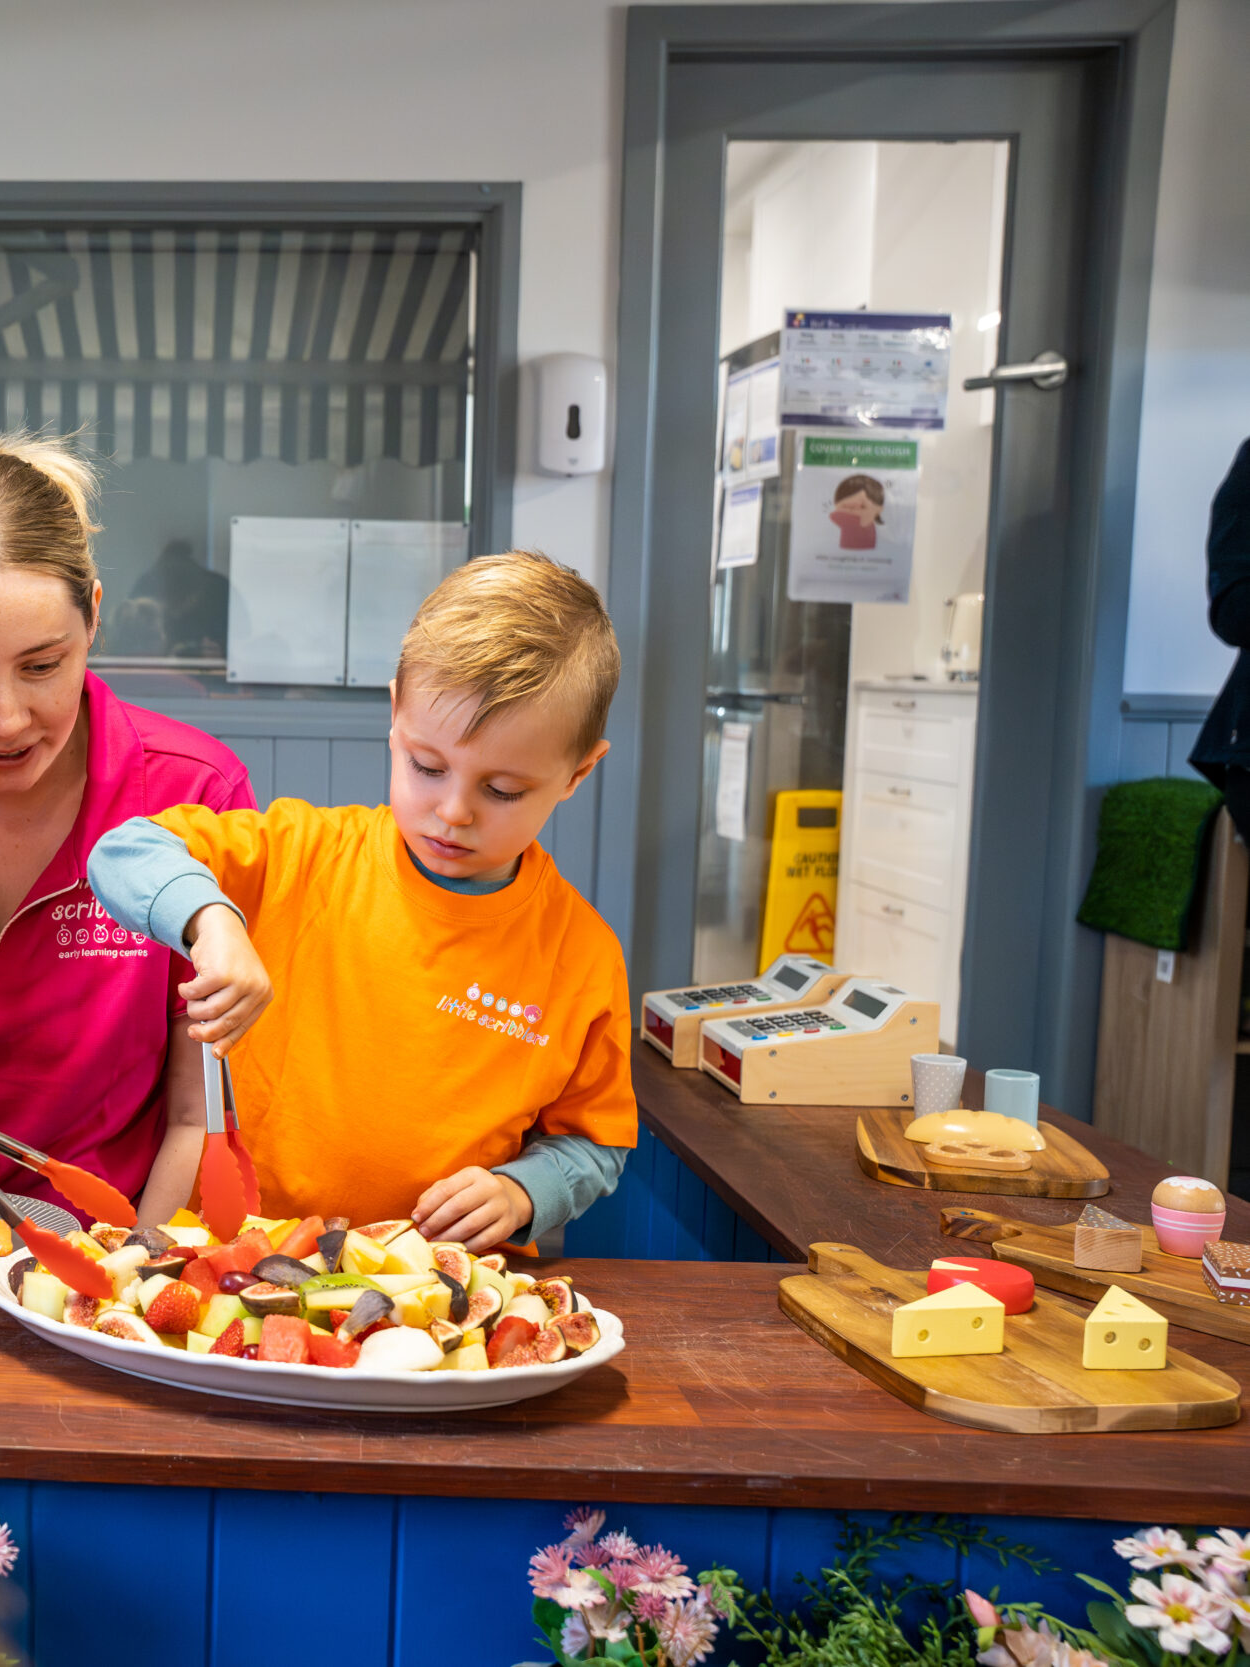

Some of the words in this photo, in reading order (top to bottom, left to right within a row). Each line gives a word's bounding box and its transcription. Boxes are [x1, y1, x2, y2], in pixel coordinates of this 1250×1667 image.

[810, 443, 842, 454] COVER
[845, 444, 871, 456] YOUR
[874, 446, 910, 457] COUGH
[794, 852, 838, 865] CAUTIO
[786, 866, 810, 878] WET
[51, 896, 112, 921] scrib
[58, 950, 81, 960] early
[81, 948, 118, 959] learning
[436, 995, 477, 1021] little
[478, 1014, 550, 1047] scribblers
